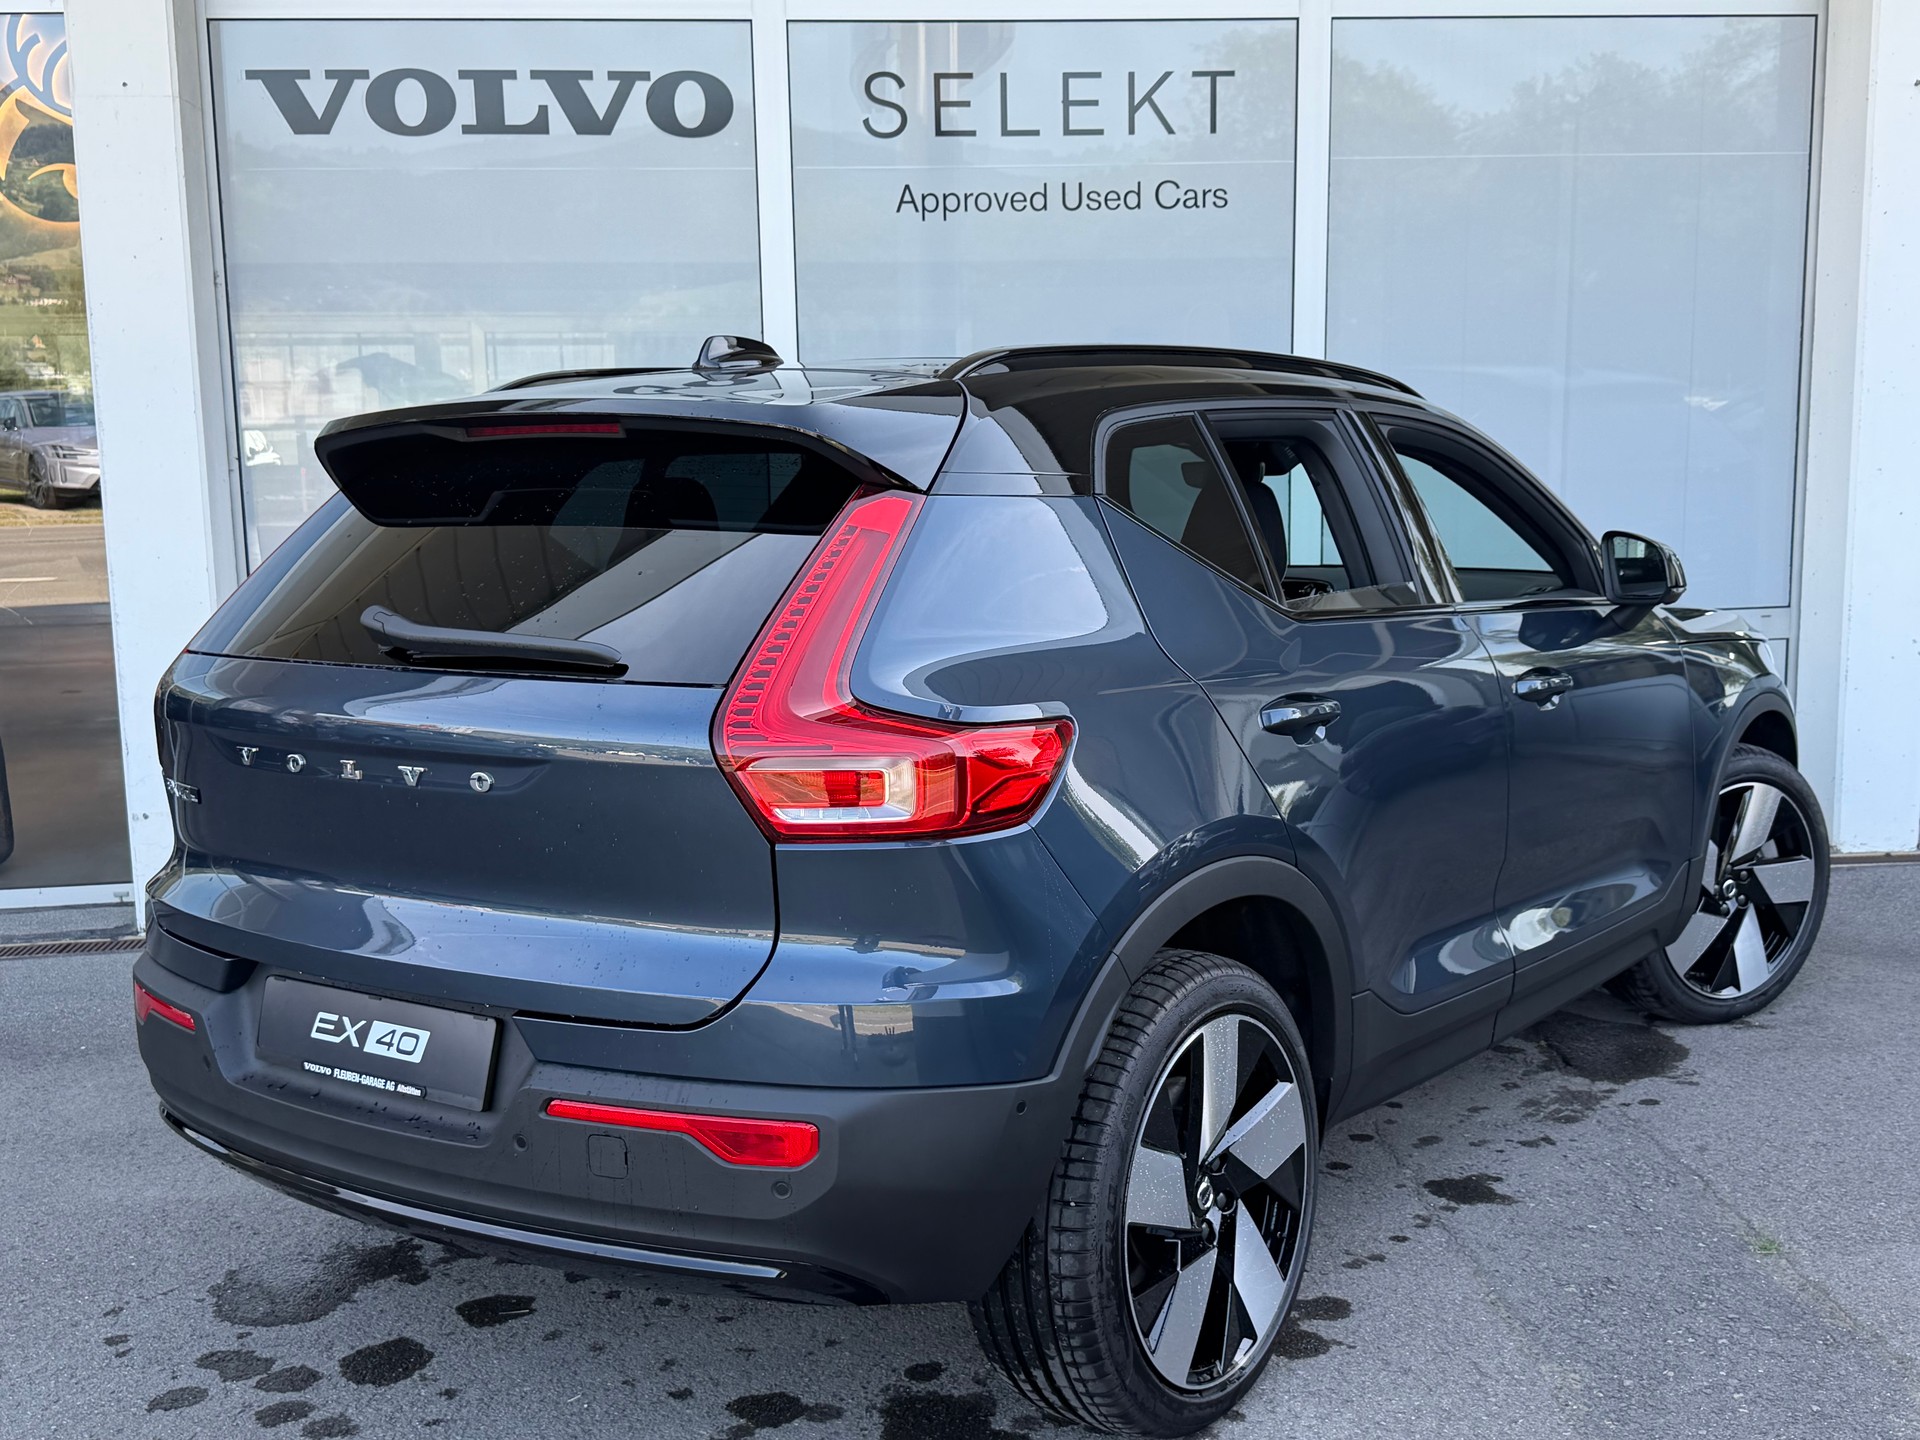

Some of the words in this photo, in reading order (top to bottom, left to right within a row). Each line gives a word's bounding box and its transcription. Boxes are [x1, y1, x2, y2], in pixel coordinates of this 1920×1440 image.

[245, 68, 734, 138] VOLVO
[862, 70, 1235, 139] SELEKT
[896, 182, 1048, 221] Approved
[1062, 181, 1141, 211] Used
[1155, 180, 1228, 209] Cars
[236, 745, 496, 793] VOLVO
[303, 1062, 332, 1075] VOLVO
[385, 1080, 396, 1091] AG
